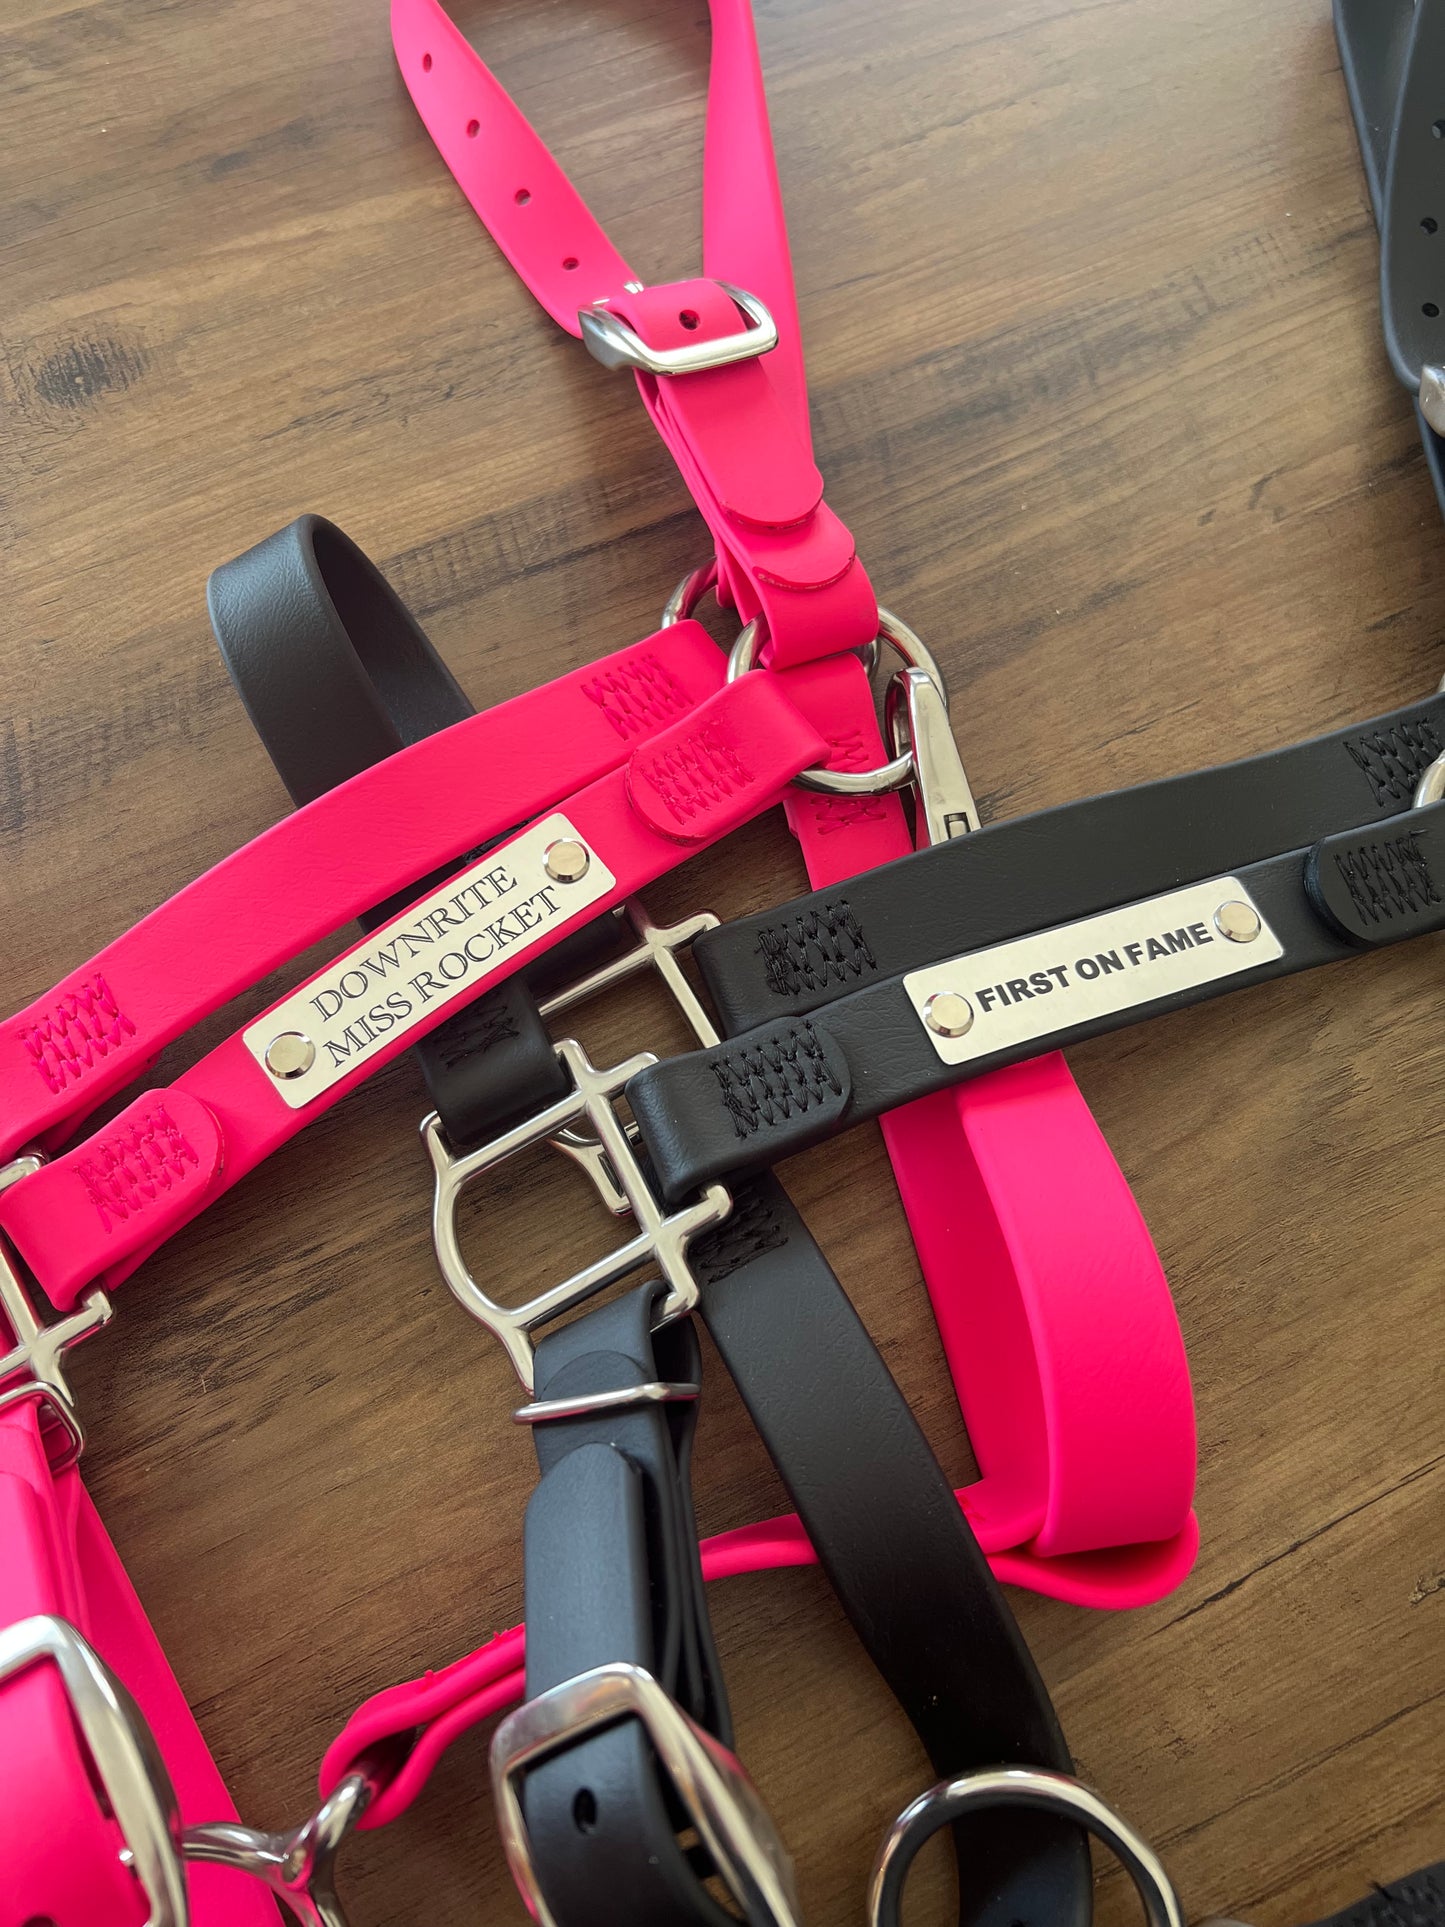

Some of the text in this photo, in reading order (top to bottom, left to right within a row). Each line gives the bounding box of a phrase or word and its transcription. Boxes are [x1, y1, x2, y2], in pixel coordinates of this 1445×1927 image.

[309, 866, 517, 1022] DOWNRITE
[322, 886, 561, 1068] MISS ROCKET
[975, 922, 1214, 1012] FIRST ON FAME
